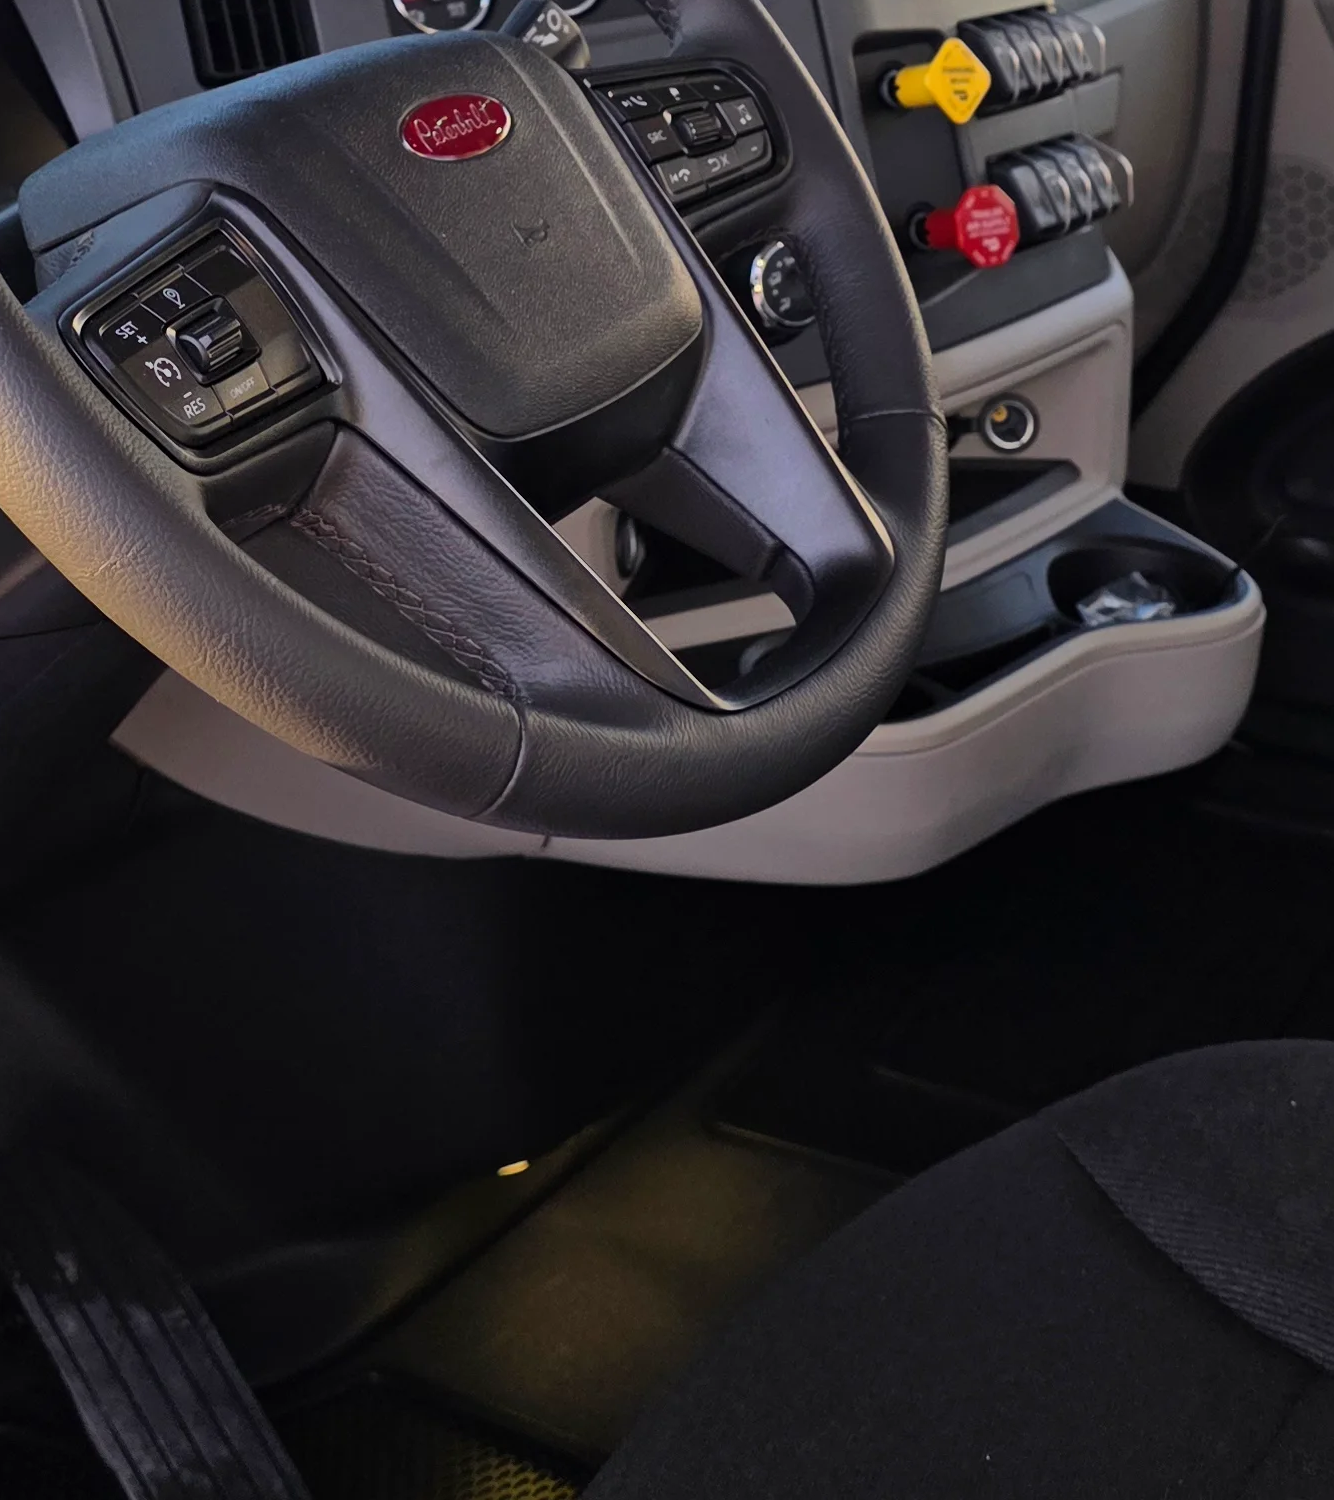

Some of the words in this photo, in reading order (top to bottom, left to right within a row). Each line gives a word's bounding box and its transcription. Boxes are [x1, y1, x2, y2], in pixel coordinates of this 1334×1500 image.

[413, 100, 497, 153] Peterbilt
[115, 320, 139, 340] SET
[229, 375, 256, 400] ON/OFF
[183, 397, 206, 419] RES
